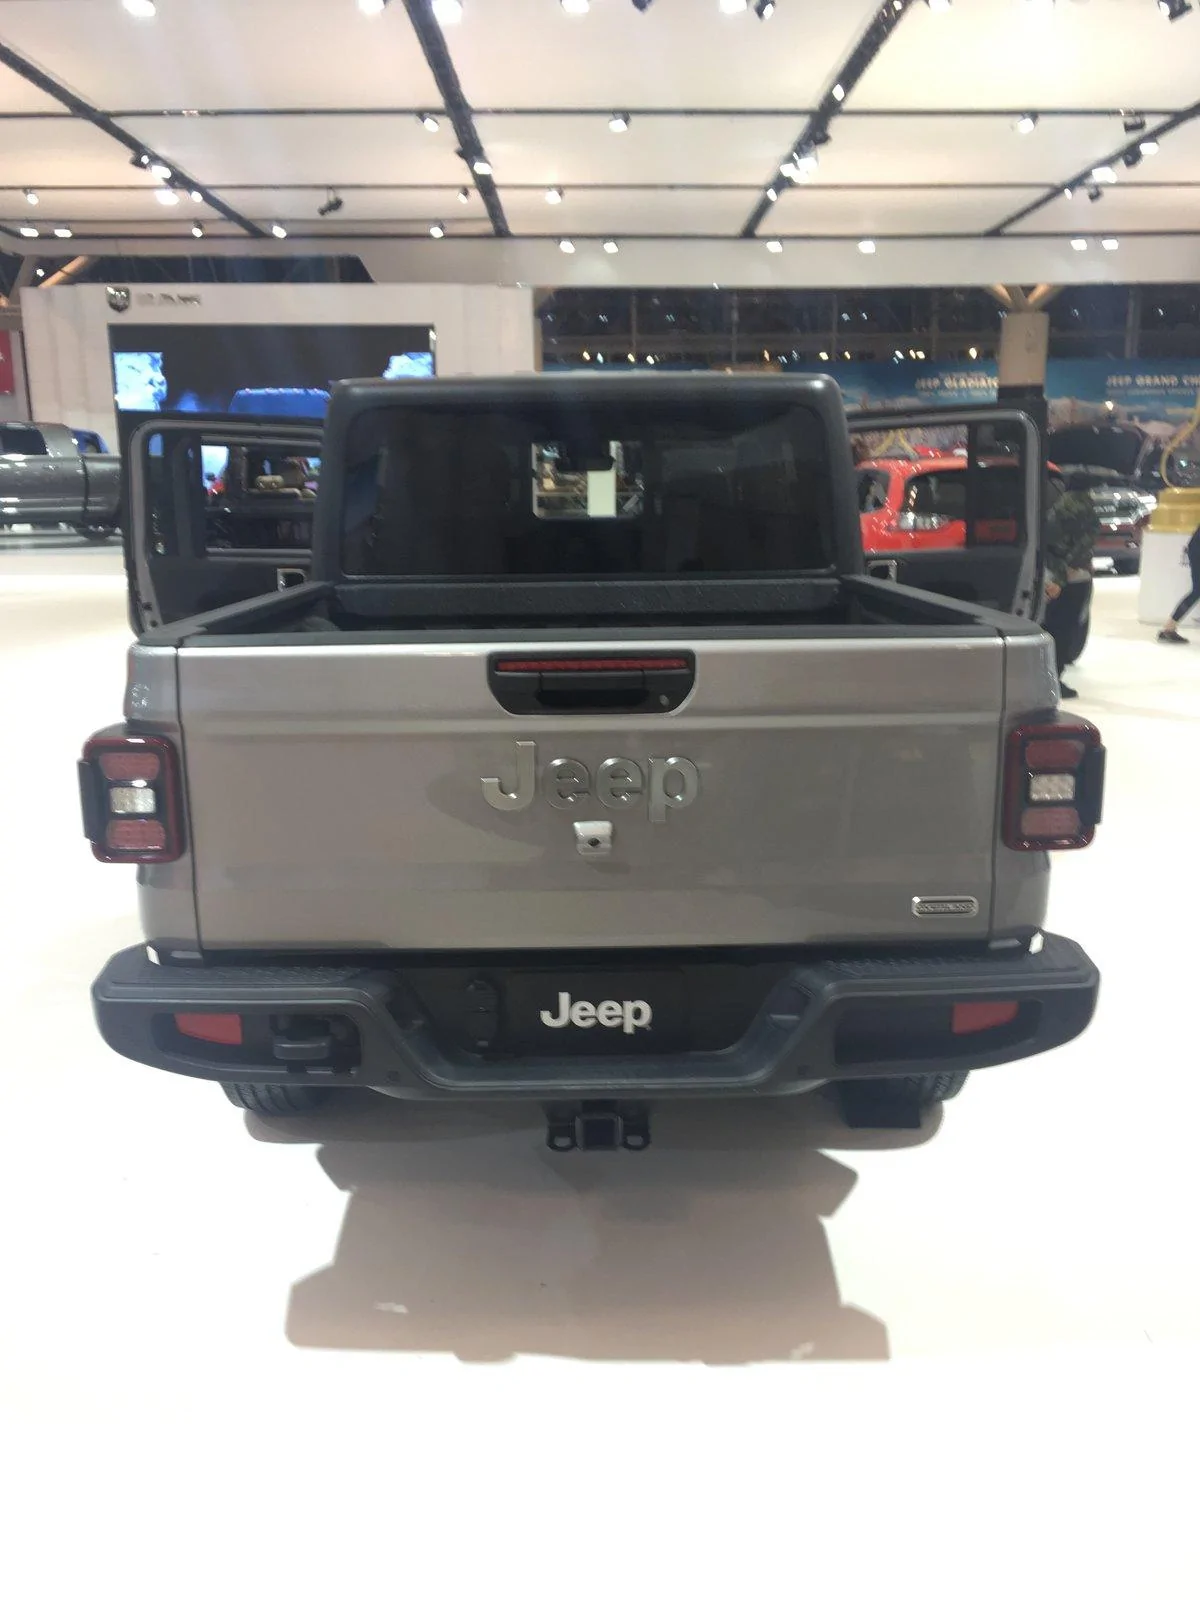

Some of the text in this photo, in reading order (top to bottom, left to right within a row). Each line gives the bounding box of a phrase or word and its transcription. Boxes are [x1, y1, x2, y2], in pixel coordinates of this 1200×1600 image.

[915, 377, 941, 389] JEEP
[1107, 375, 1132, 387] JEEP
[480, 740, 700, 822] Jeep
[540, 991, 653, 1035] Jeep
